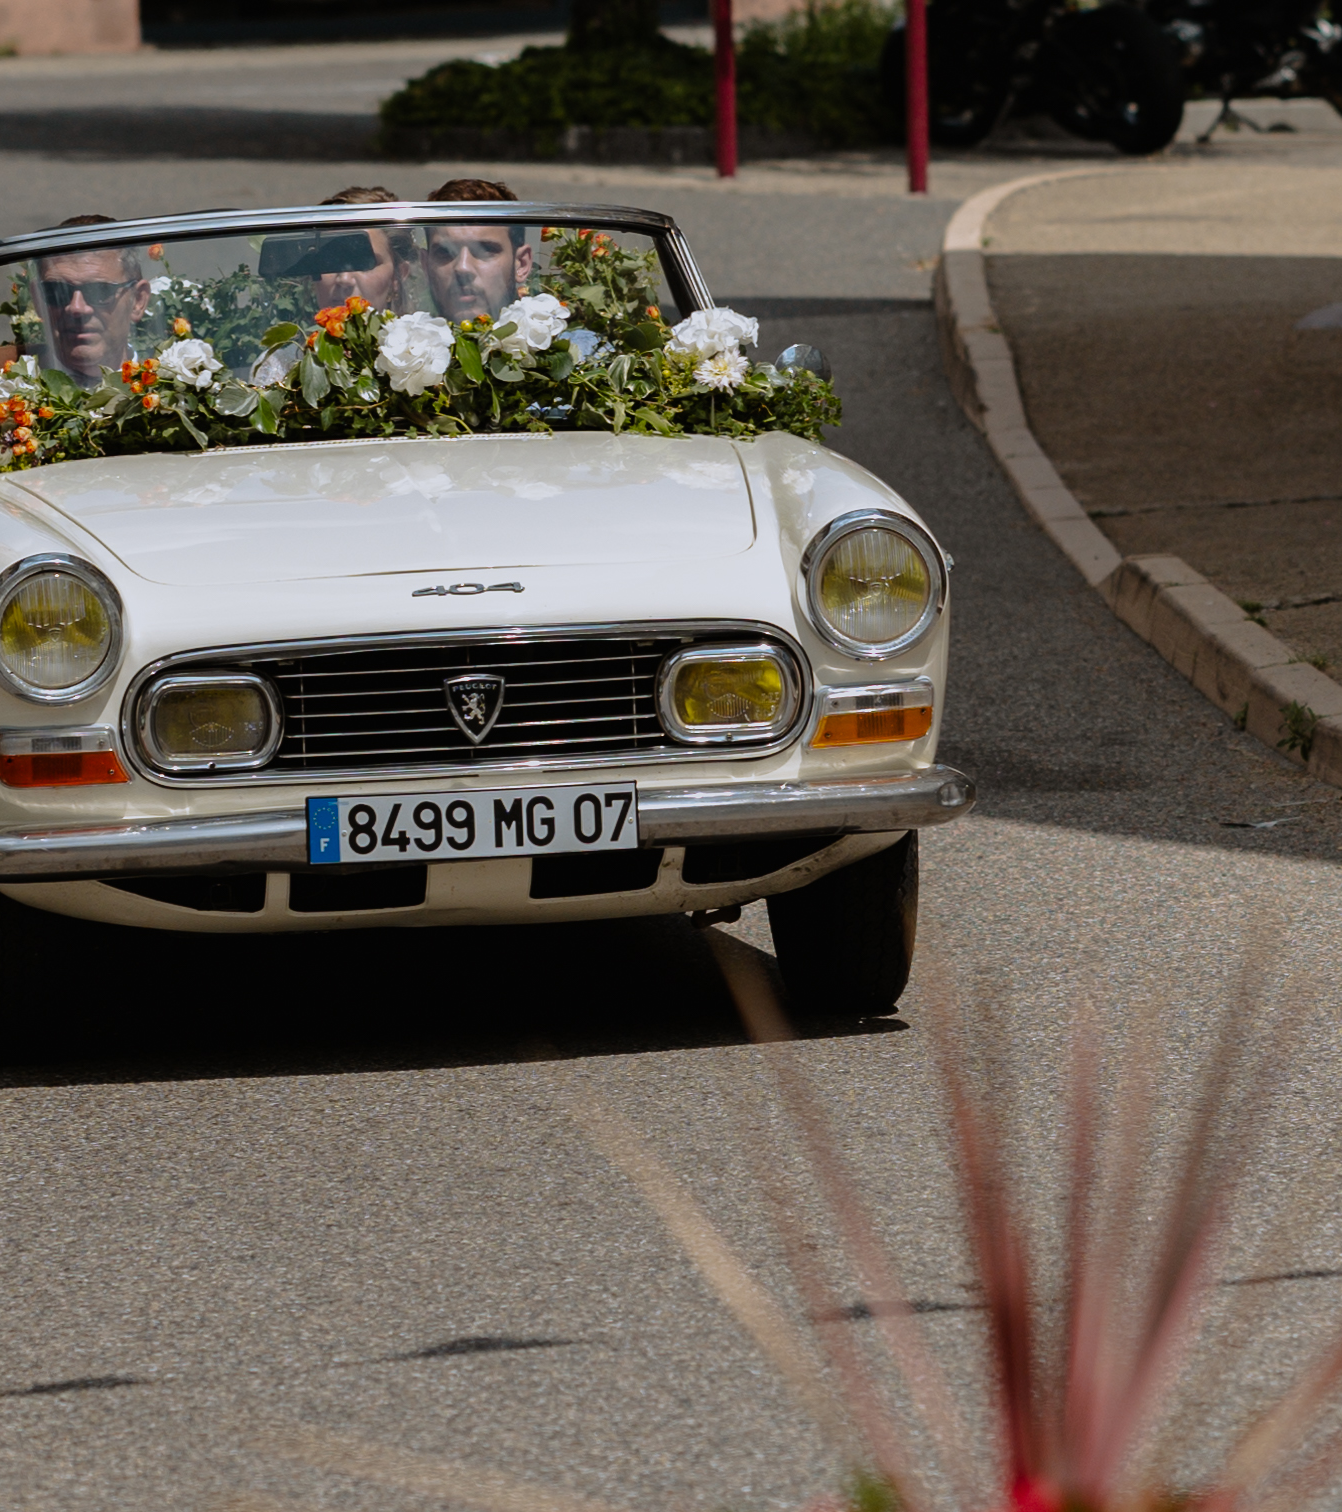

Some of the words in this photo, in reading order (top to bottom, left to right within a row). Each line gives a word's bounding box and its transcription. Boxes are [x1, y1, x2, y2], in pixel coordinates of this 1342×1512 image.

[411, 581, 526, 598] 404
[451, 682, 498, 693] PEUGEOT
[347, 799, 477, 855] 8499
[493, 794, 557, 849] MG
[573, 790, 634, 844] 07
[319, 838, 331, 853] F
